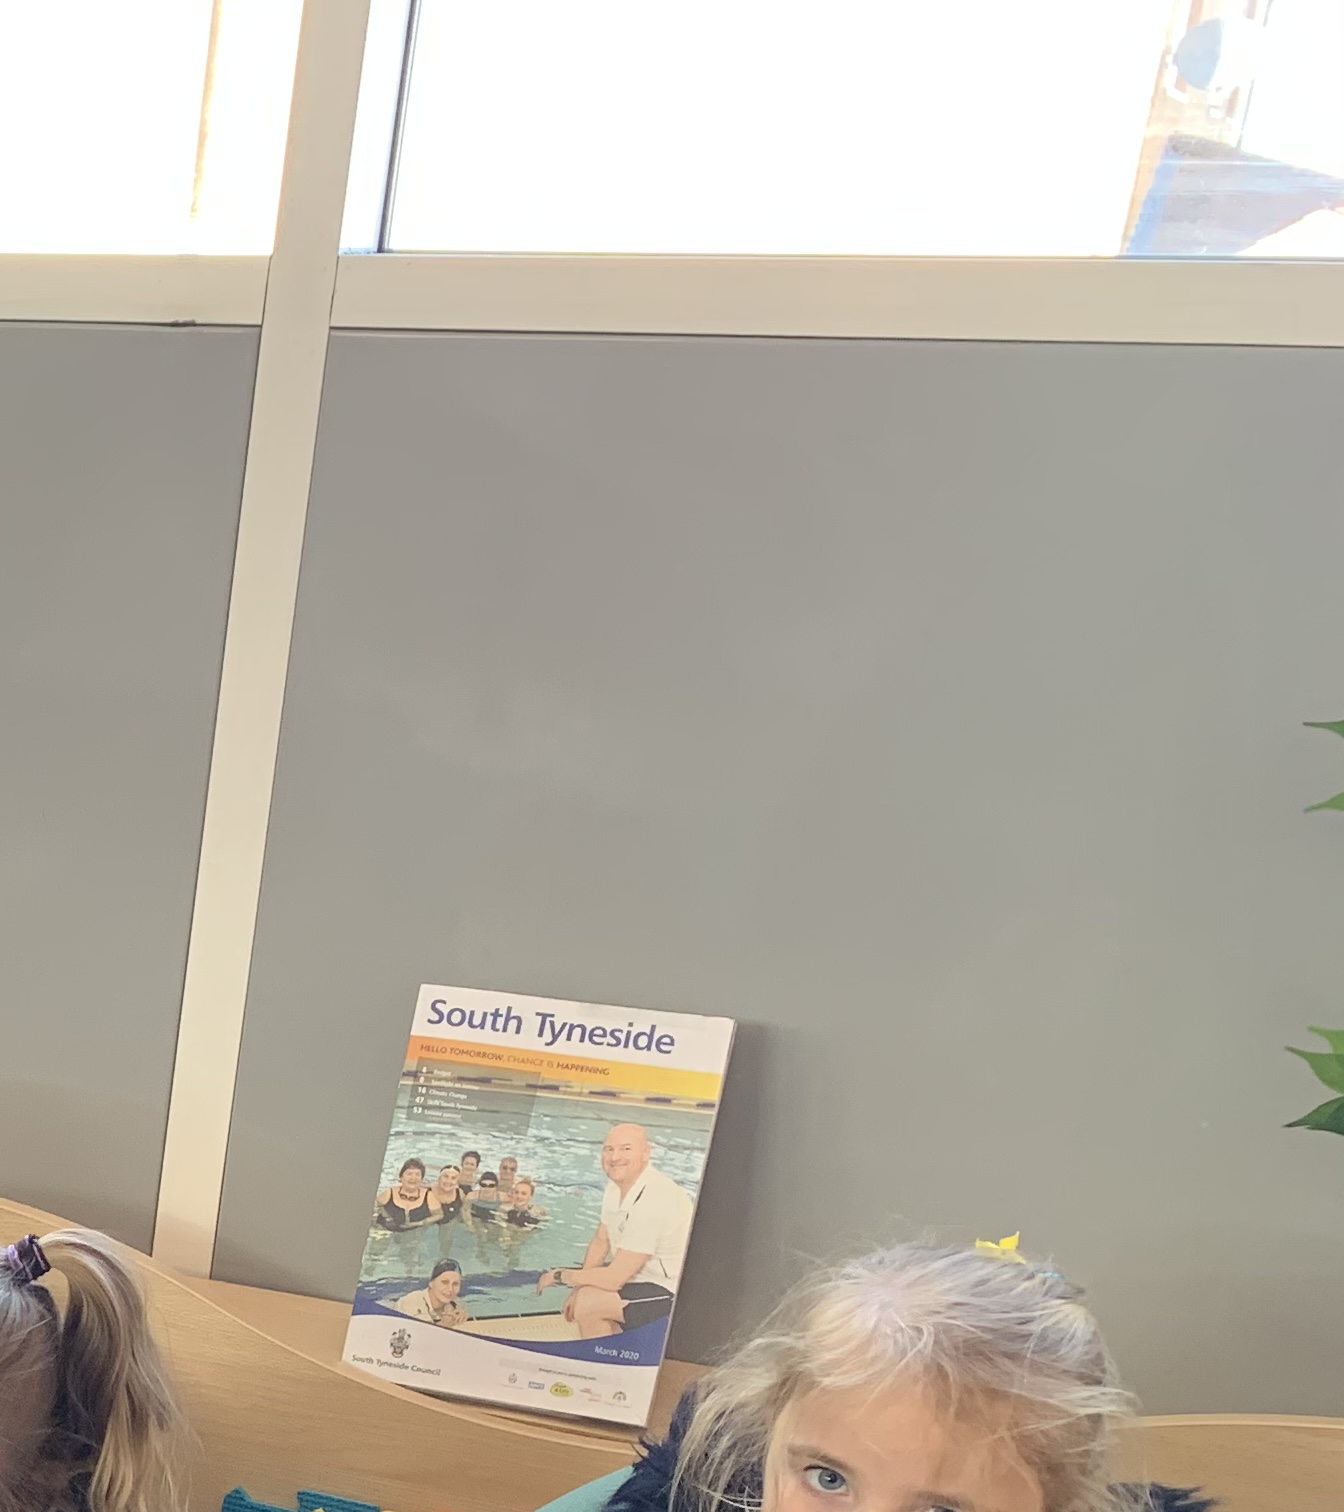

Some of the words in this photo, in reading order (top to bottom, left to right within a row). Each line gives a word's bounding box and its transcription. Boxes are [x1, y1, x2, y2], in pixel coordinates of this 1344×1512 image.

[426, 996, 524, 1035] South
[531, 1010, 677, 1061] Tyneside
[419, 1043, 447, 1055] HELLO
[448, 1047, 504, 1063] TOMORROW,
[506, 1054, 544, 1067] CHANGE
[546, 1060, 554, 1068] IS
[556, 1061, 609, 1076] HAPPENING
[414, 1096, 424, 1104] 47
[413, 1106, 423, 1114] 53
[594, 1345, 618, 1358] March
[620, 1349, 640, 1361] 2020
[352, 1354, 374, 1365] South
[375, 1358, 409, 1372] Tyneside
[410, 1364, 441, 1376] Council
